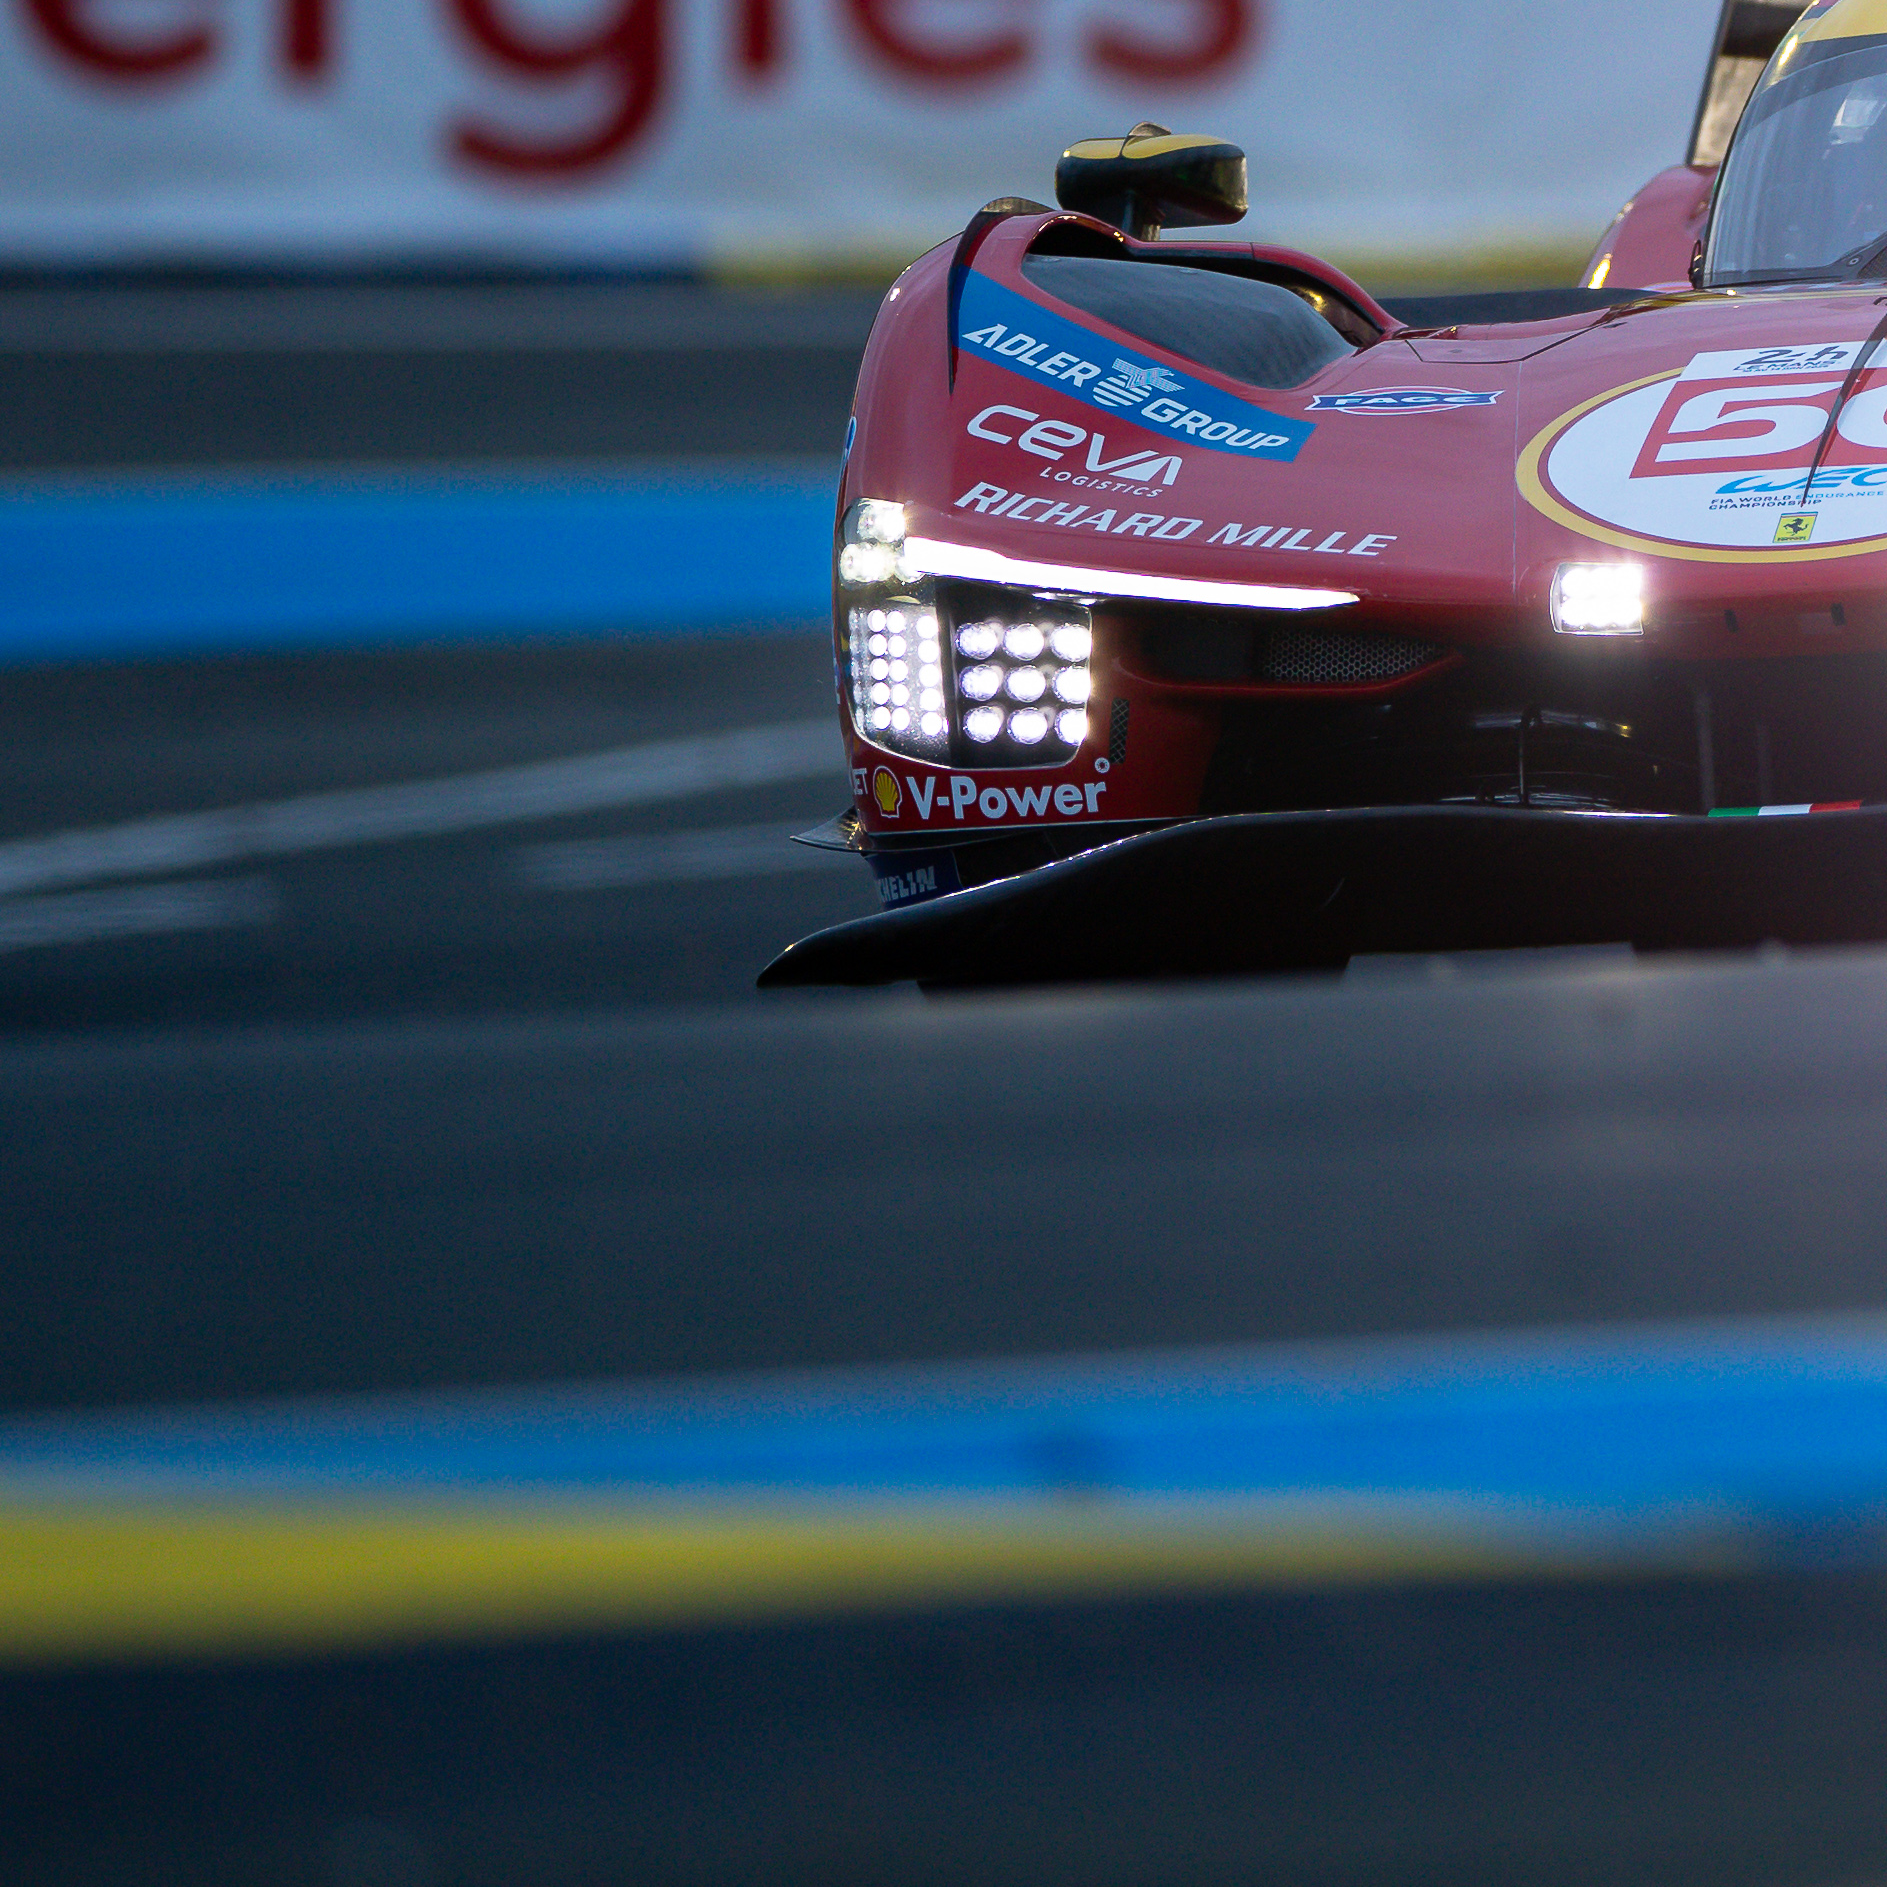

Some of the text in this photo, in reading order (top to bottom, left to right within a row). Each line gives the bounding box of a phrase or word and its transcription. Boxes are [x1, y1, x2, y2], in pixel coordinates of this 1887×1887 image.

[961, 323, 1289, 452] ADLER GROUP
[1039, 466, 1164, 498] LOGISTICS
[1796, 490, 1884, 500] ENDURANCE
[955, 481, 1398, 557] RICHARD MILLE
[906, 775, 1107, 820] V-Power
